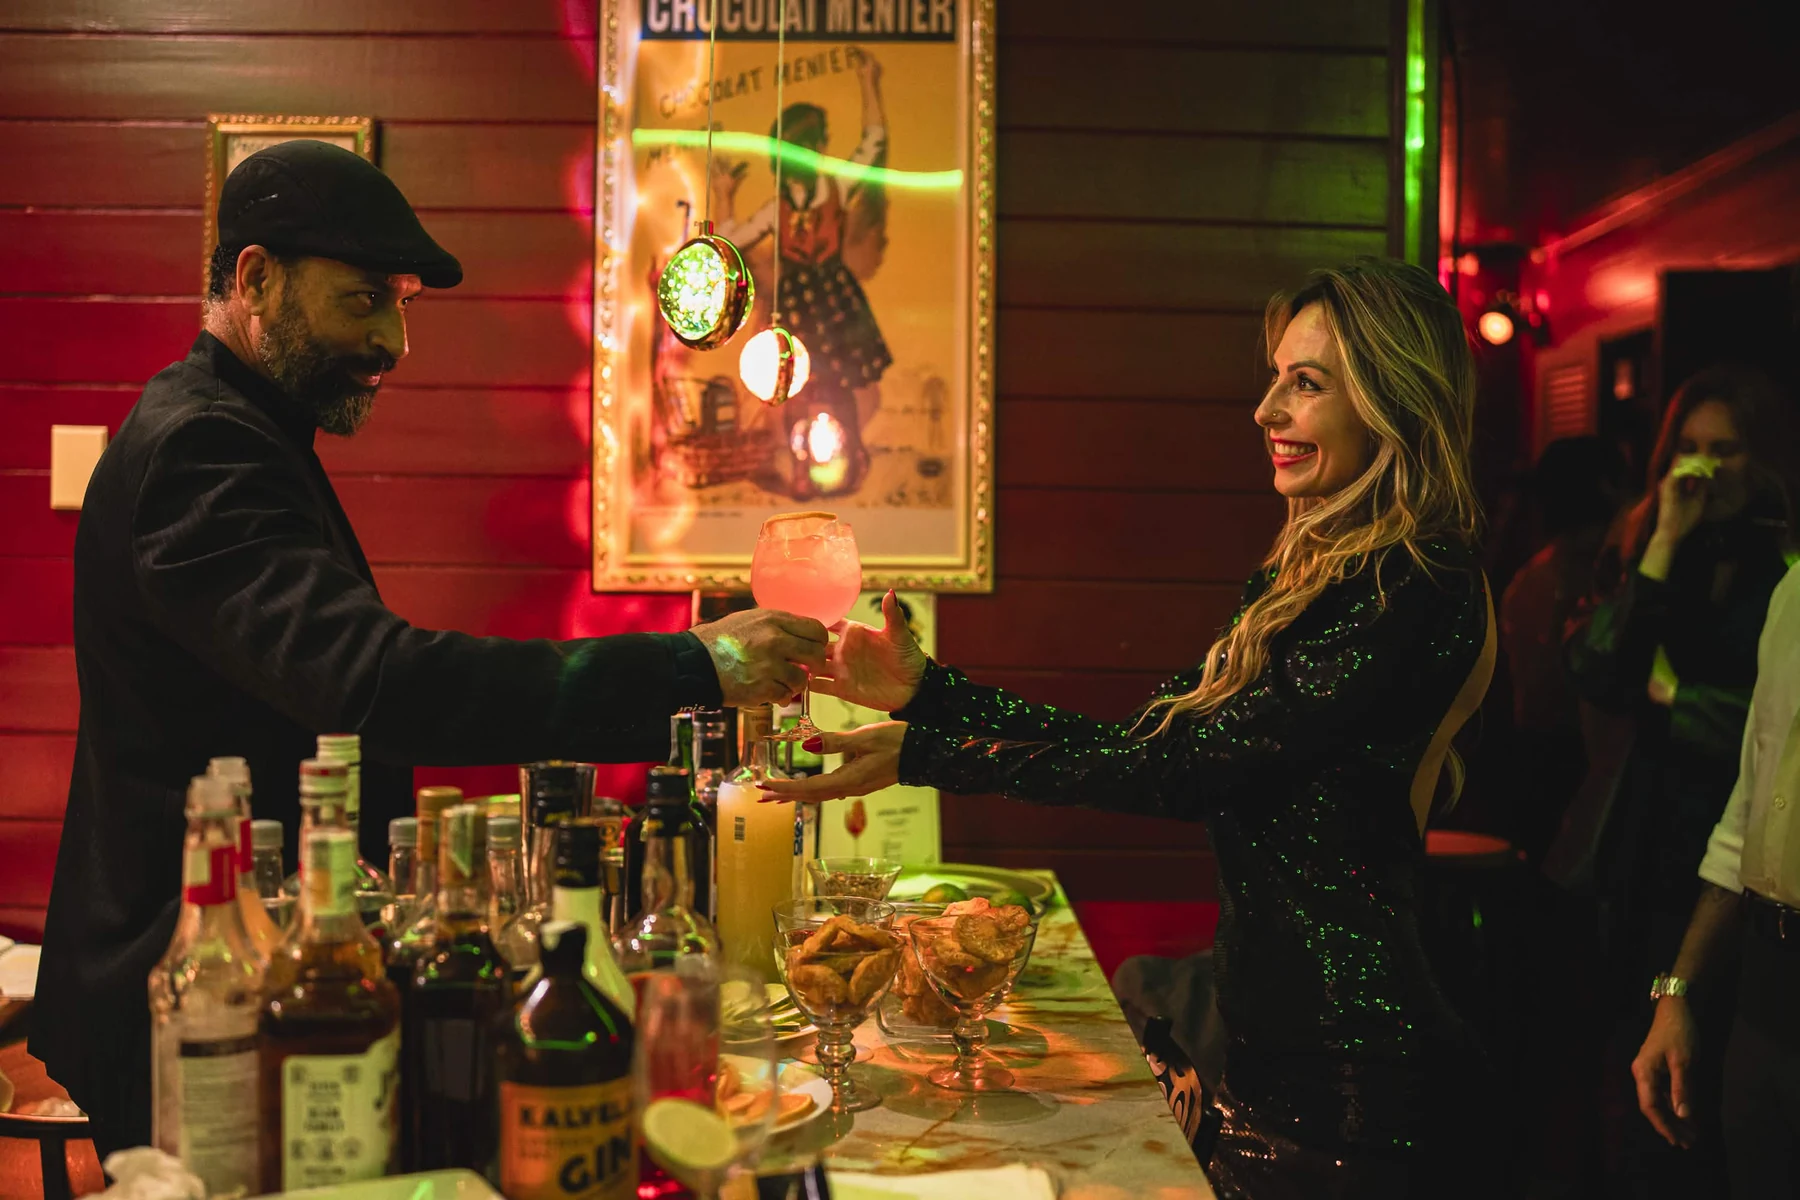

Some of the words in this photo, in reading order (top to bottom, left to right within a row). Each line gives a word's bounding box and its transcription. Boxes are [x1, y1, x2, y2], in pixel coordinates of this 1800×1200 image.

[647, 0, 816, 33] CHOCOLAT
[826, 0, 952, 33] MENIER
[659, 66, 763, 118] CCOLAT
[558, 1125, 632, 1194] GIN
